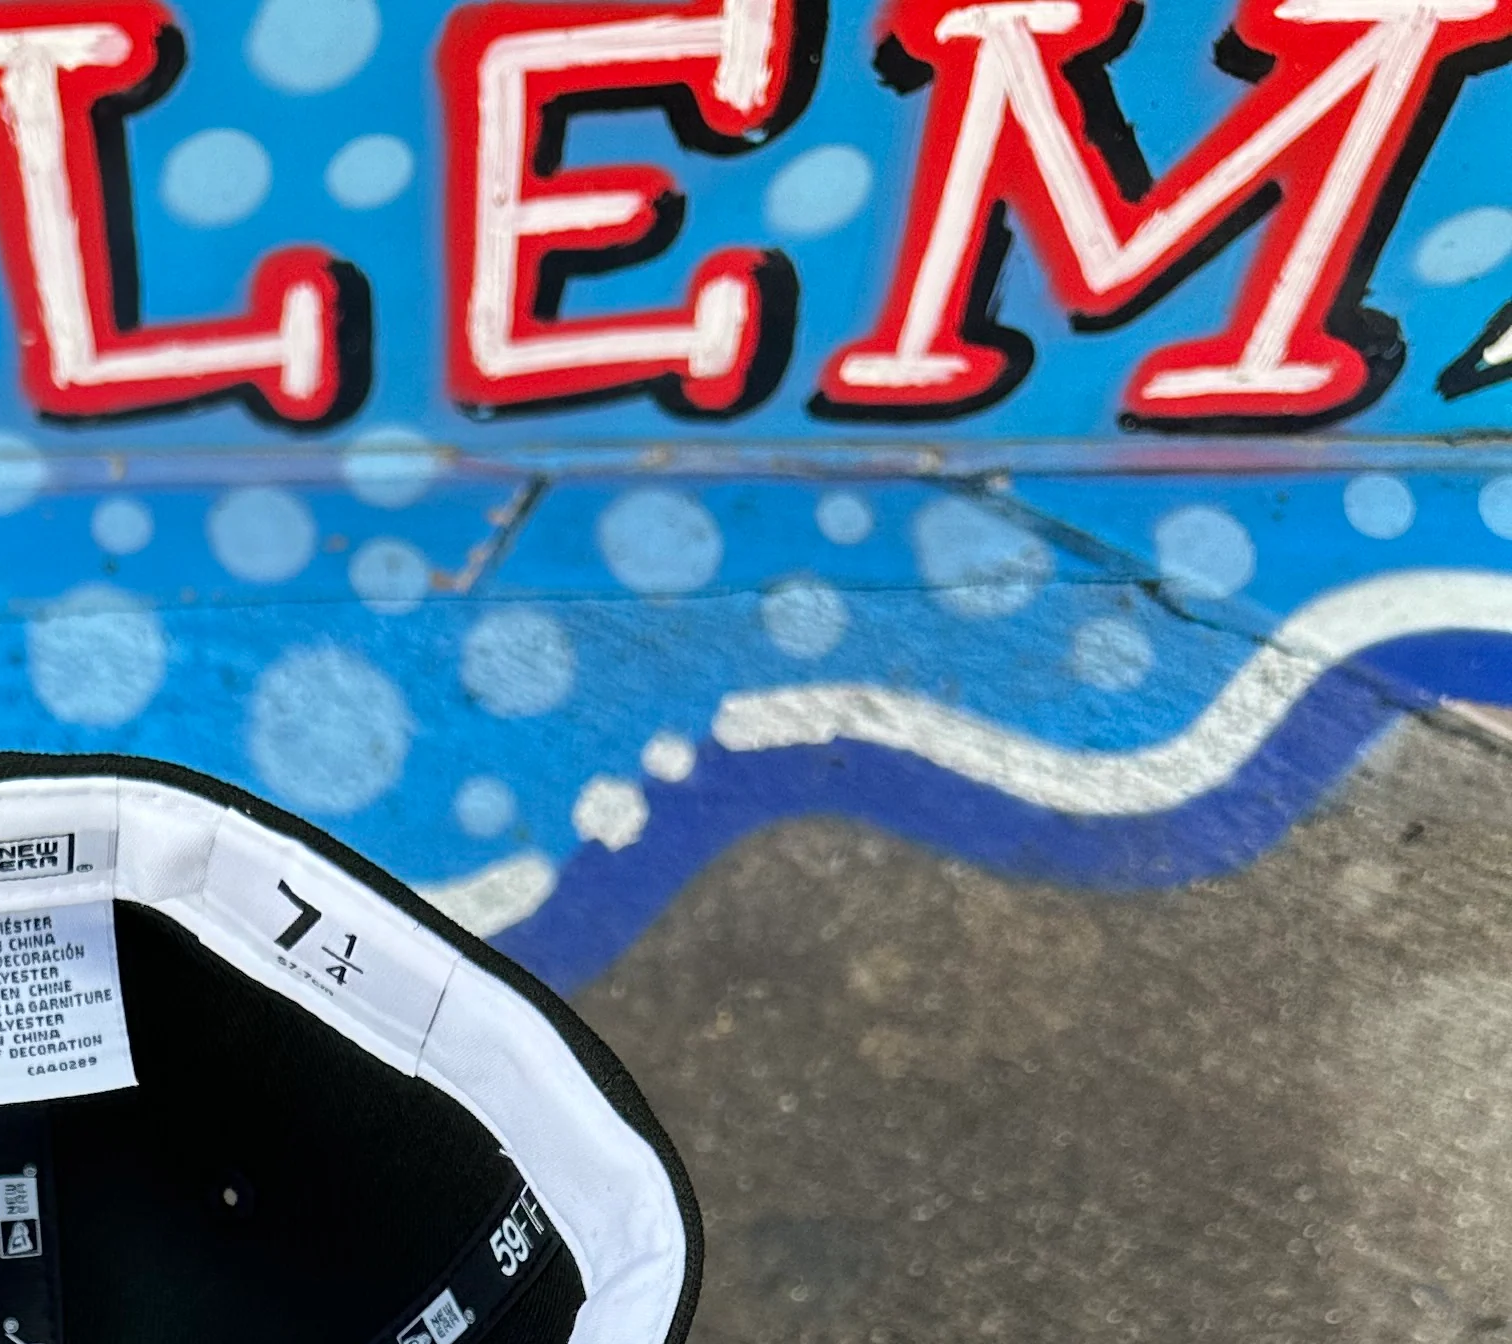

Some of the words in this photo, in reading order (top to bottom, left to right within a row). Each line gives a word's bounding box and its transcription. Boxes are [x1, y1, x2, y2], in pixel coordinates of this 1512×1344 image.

[274, 878, 322, 952] 7
[8, 933, 57, 951] CHINA
[0, 988, 21, 1001] EN
[28, 980, 74, 997] CHINE
[5, 1002, 26, 1016] LA
[28, 989, 113, 1014] GARNITURE
[9, 1034, 103, 1060] DECORATION
[13, 1029, 61, 1044] CHINA
[489, 1184, 544, 1277] 59FIF
